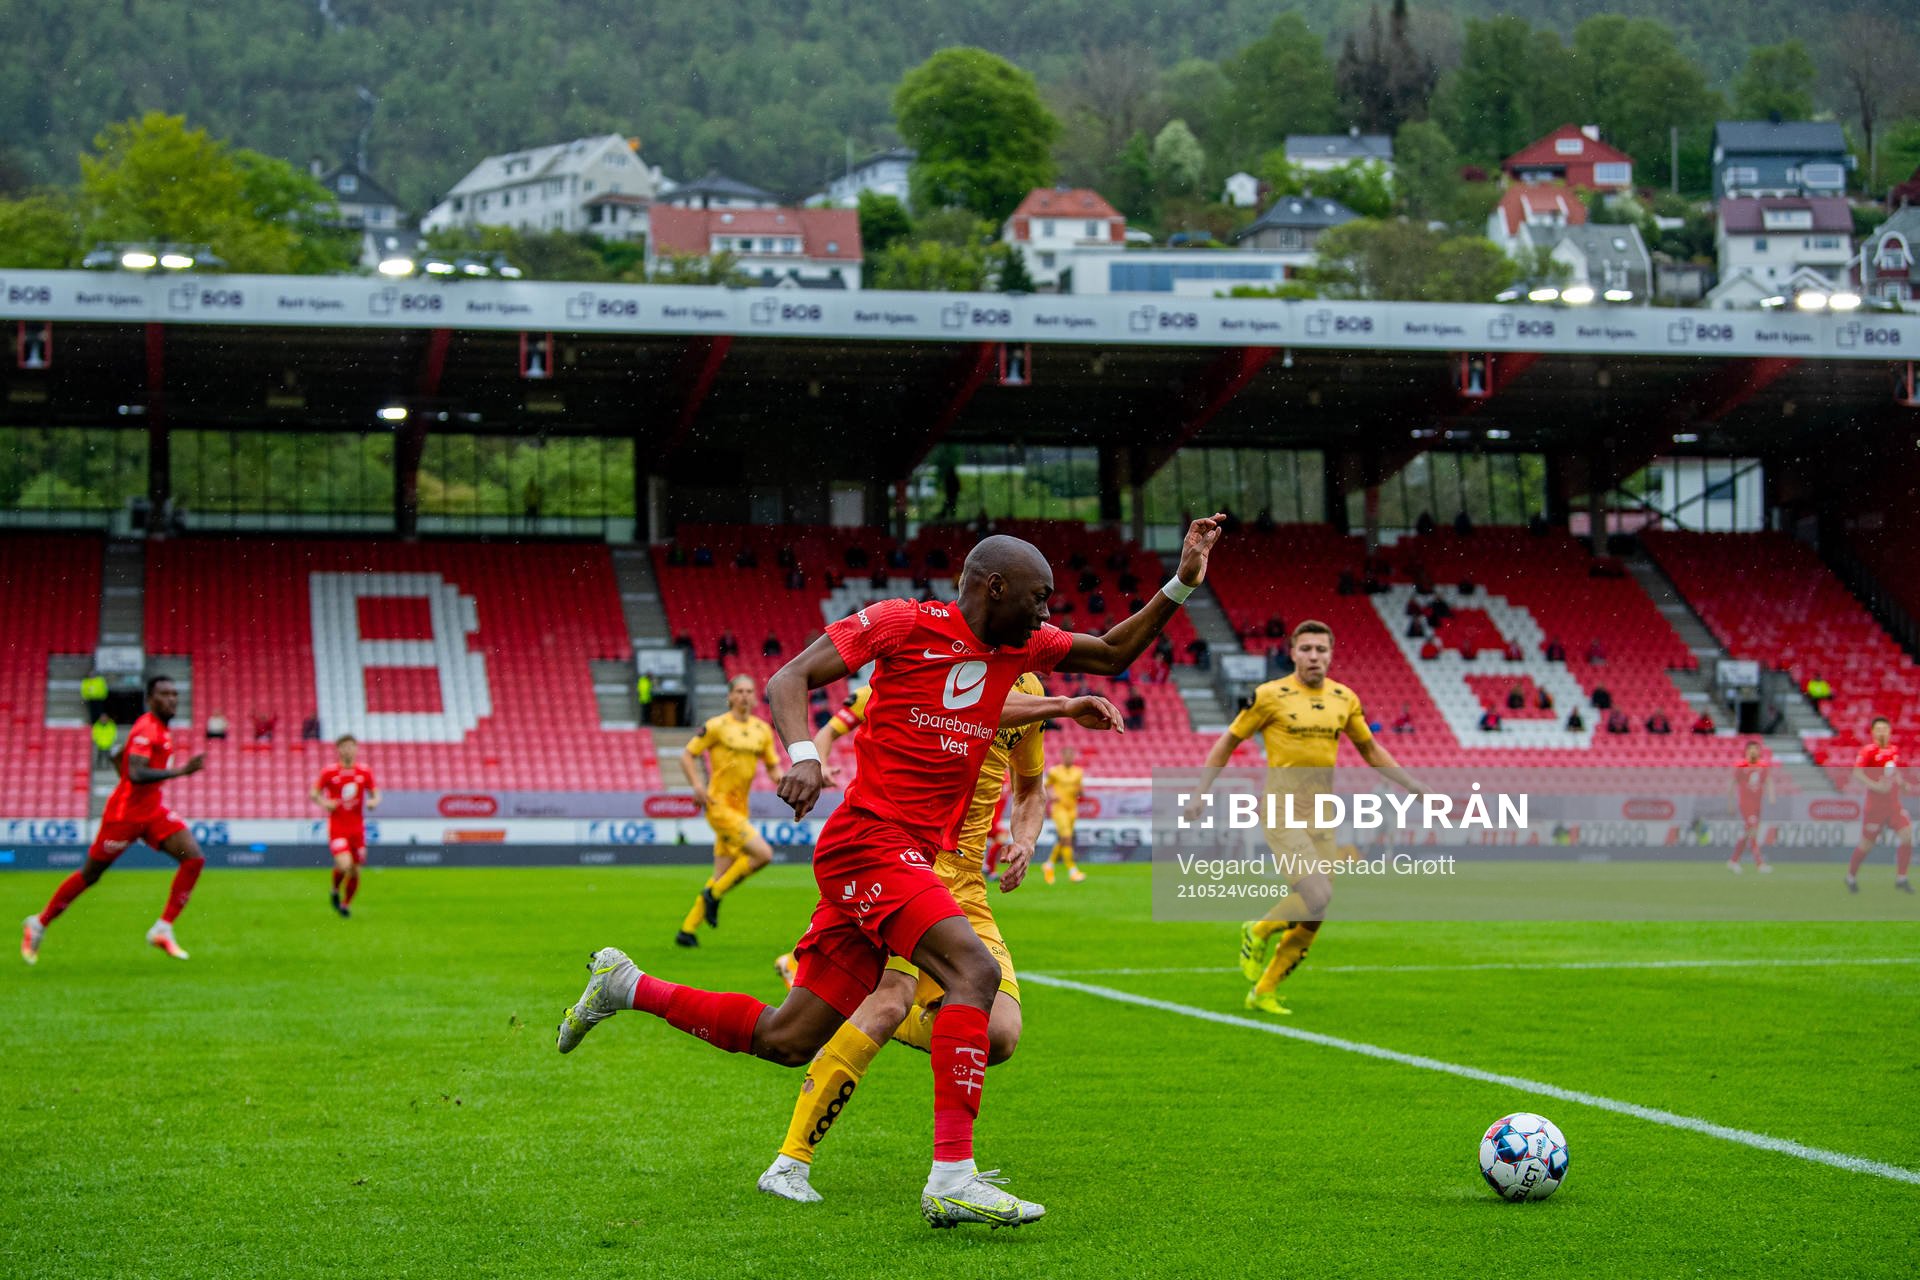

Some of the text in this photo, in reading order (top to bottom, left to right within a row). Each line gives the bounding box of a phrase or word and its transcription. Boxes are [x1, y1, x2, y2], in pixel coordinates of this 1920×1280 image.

[9, 286, 51, 303] BOB
[201, 289, 243, 306] BOB
[400, 294, 442, 311] BOB
[598, 299, 639, 315] BOB
[781, 304, 822, 320] BOB
[972, 309, 1012, 324] BOB
[1158, 313, 1198, 328] BOB
[1334, 317, 1373, 332] BOB
[1517, 321, 1555, 337] BOB
[1696, 324, 1734, 341] BOB
[1864, 328, 1902, 345] BOB
[930, 606, 950, 618] BOB
[908, 706, 993, 741] Sparebanken
[940, 734, 969, 757] Vest
[29, 820, 78, 844] LOS
[192, 820, 230, 845] OS
[608, 821, 657, 845] LOS
[761, 821, 813, 845] LOS
